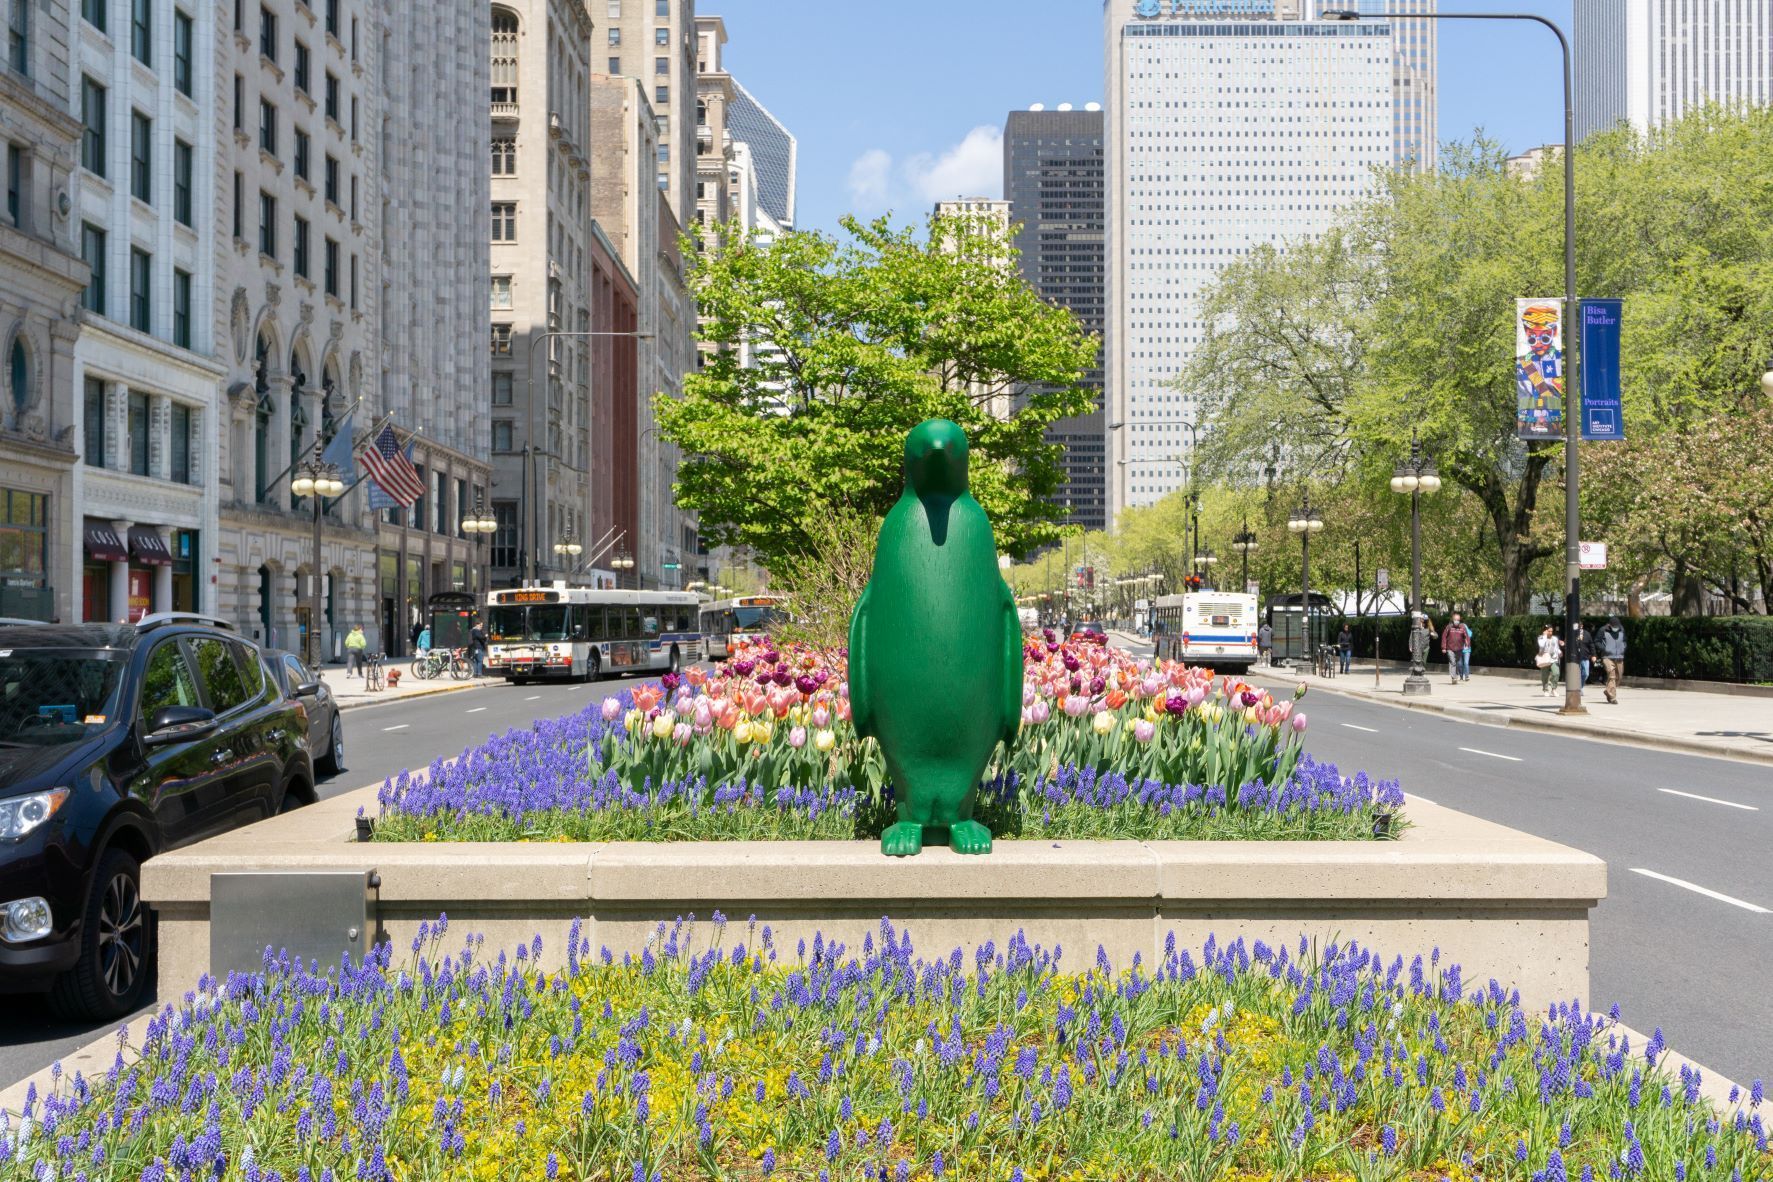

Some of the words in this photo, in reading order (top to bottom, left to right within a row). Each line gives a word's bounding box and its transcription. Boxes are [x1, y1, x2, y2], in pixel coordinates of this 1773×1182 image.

[1587, 305, 1606, 314] Bisa
[1587, 315, 1616, 324] Butler
[501, 593, 507, 604] 3
